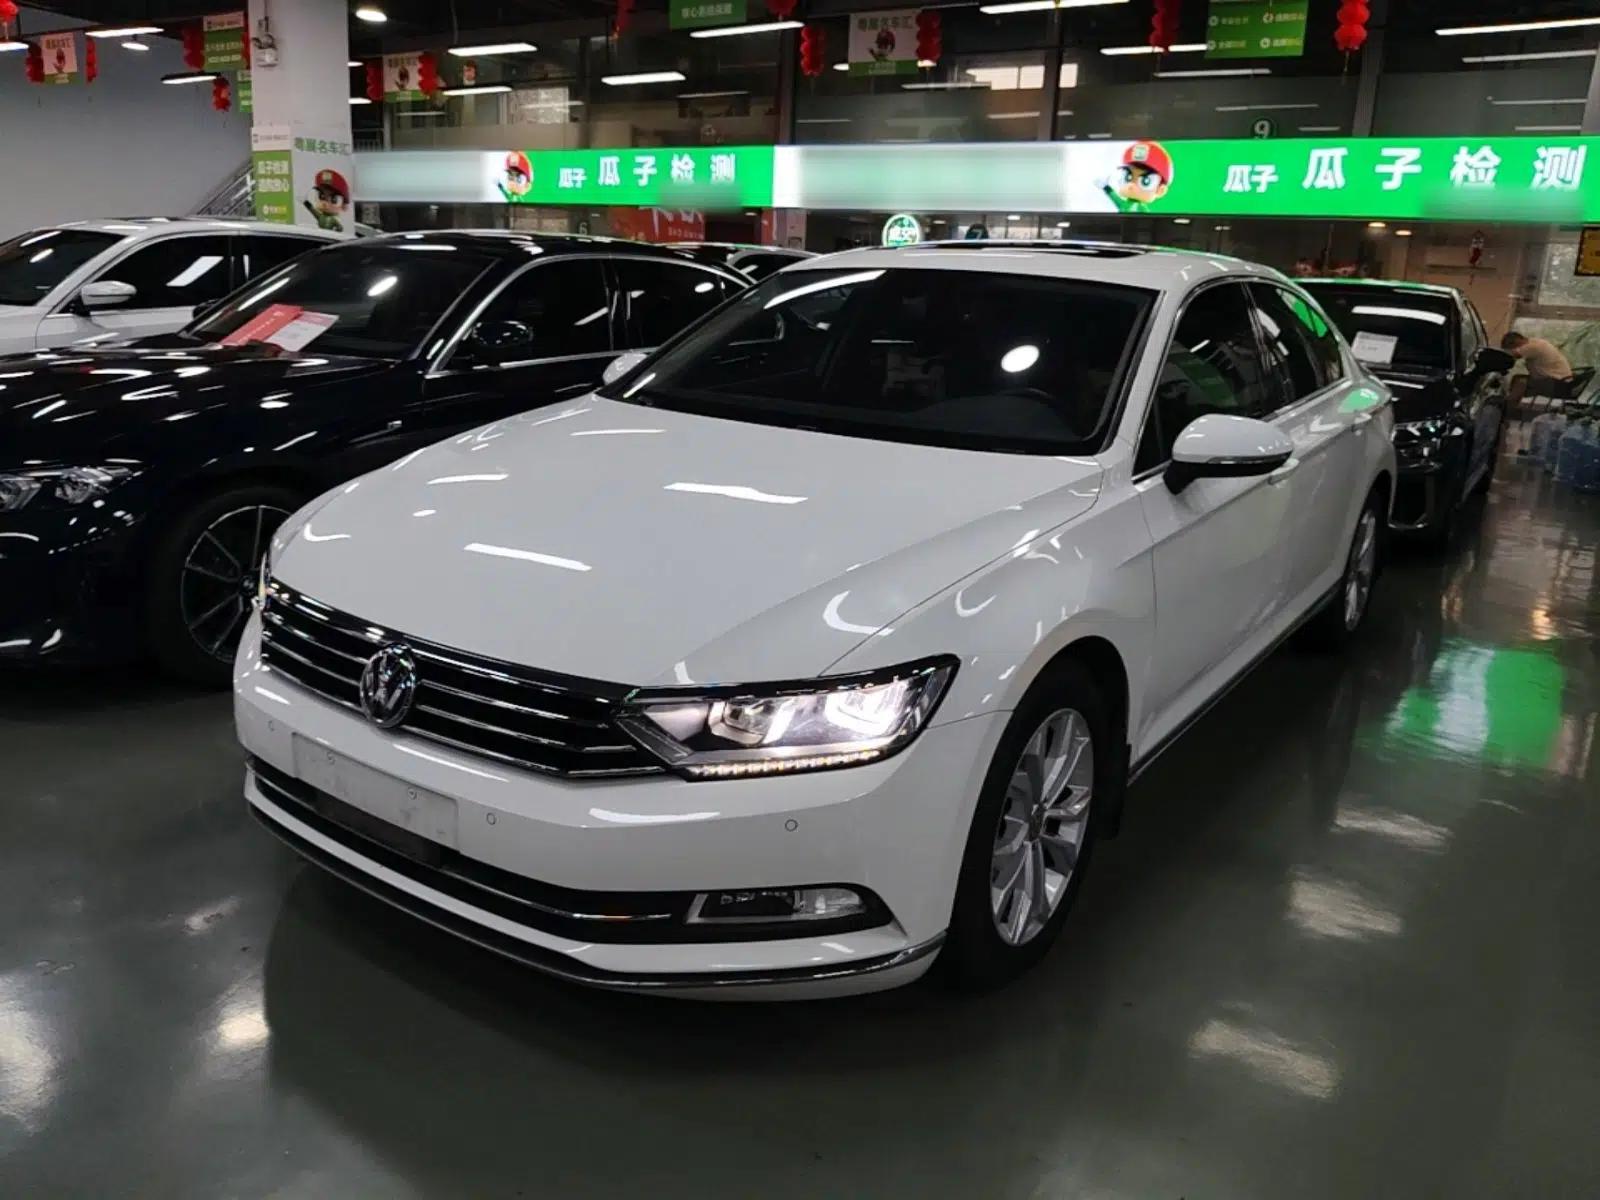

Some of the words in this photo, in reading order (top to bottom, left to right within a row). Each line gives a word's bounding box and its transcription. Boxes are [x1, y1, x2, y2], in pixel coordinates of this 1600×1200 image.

[558, 168, 587, 188] 瓜子
[599, 154, 735, 187] 瓜子检测
[1223, 165, 1278, 192] 瓜子
[1303, 145, 1588, 191] 瓜子检测
